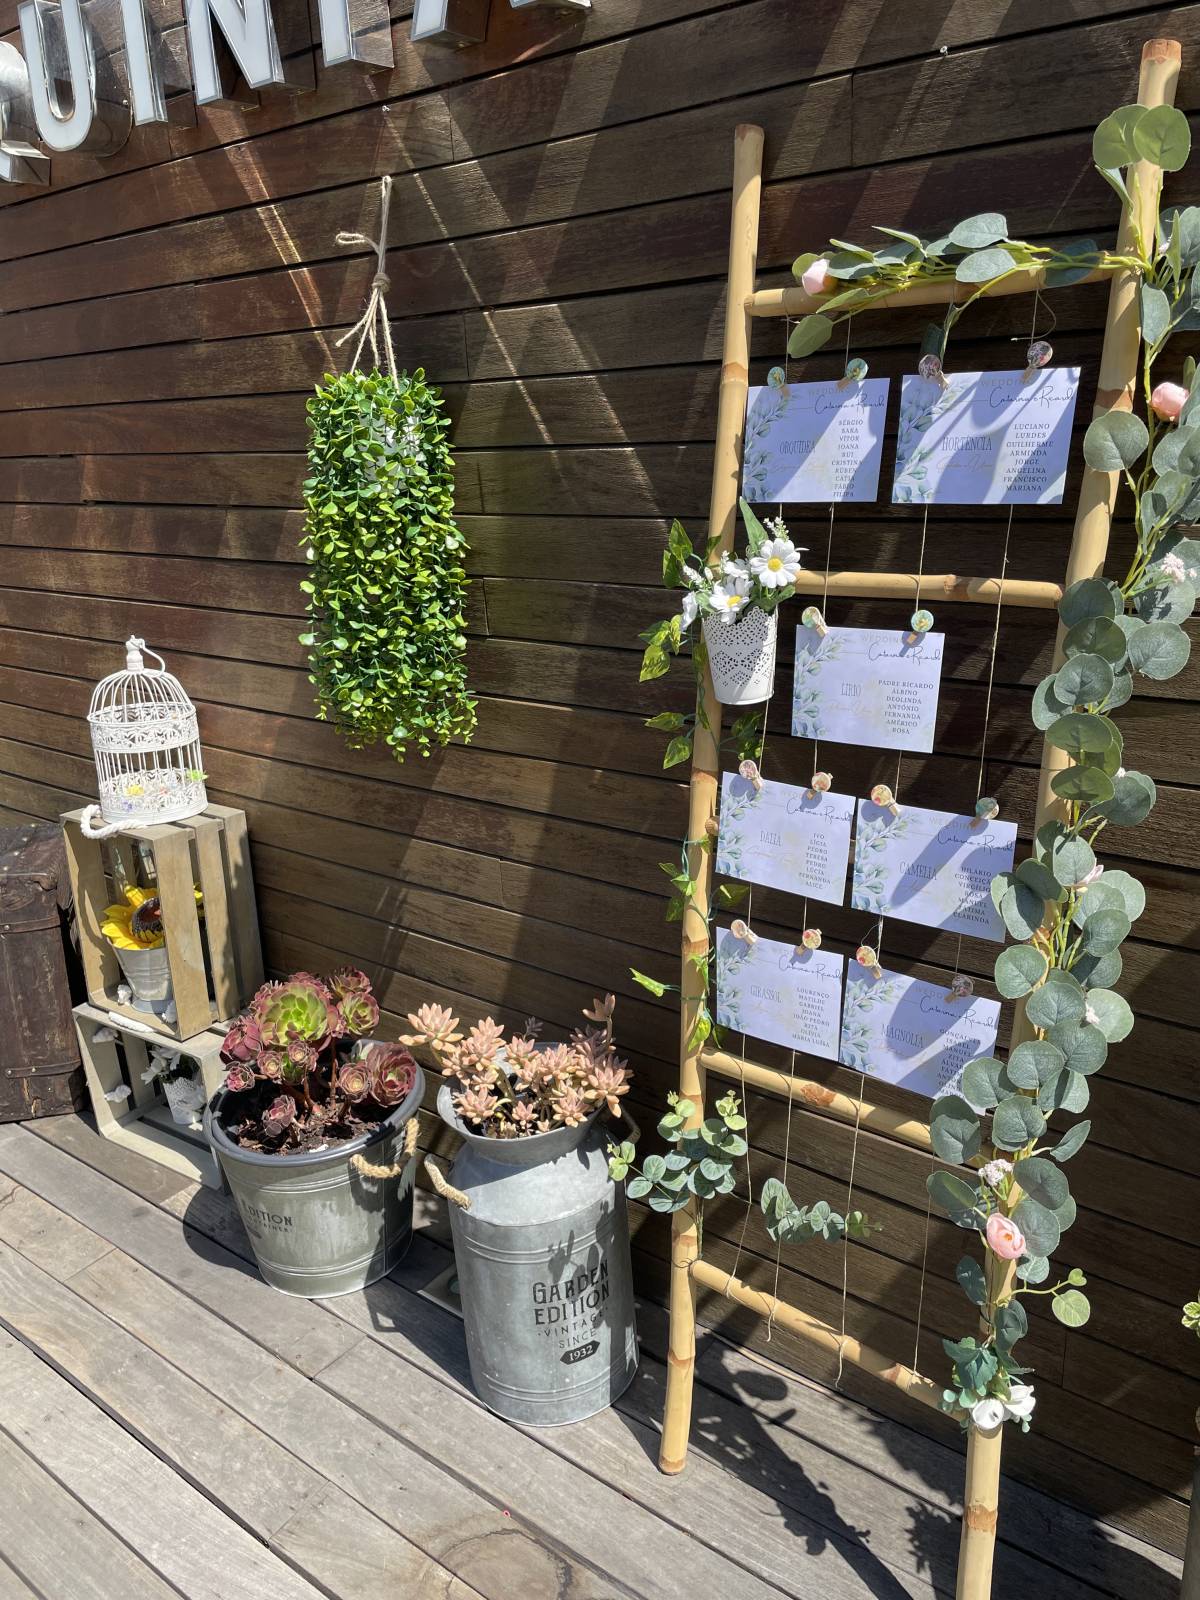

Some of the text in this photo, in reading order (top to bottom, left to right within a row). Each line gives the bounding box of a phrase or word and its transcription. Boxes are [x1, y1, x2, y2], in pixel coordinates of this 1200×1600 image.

[532, 1259, 609, 1304] GARDEN
[534, 1280, 610, 1325] EDITION
[559, 1328, 597, 1349] SINCE
[569, 1344, 594, 1361] 1932
